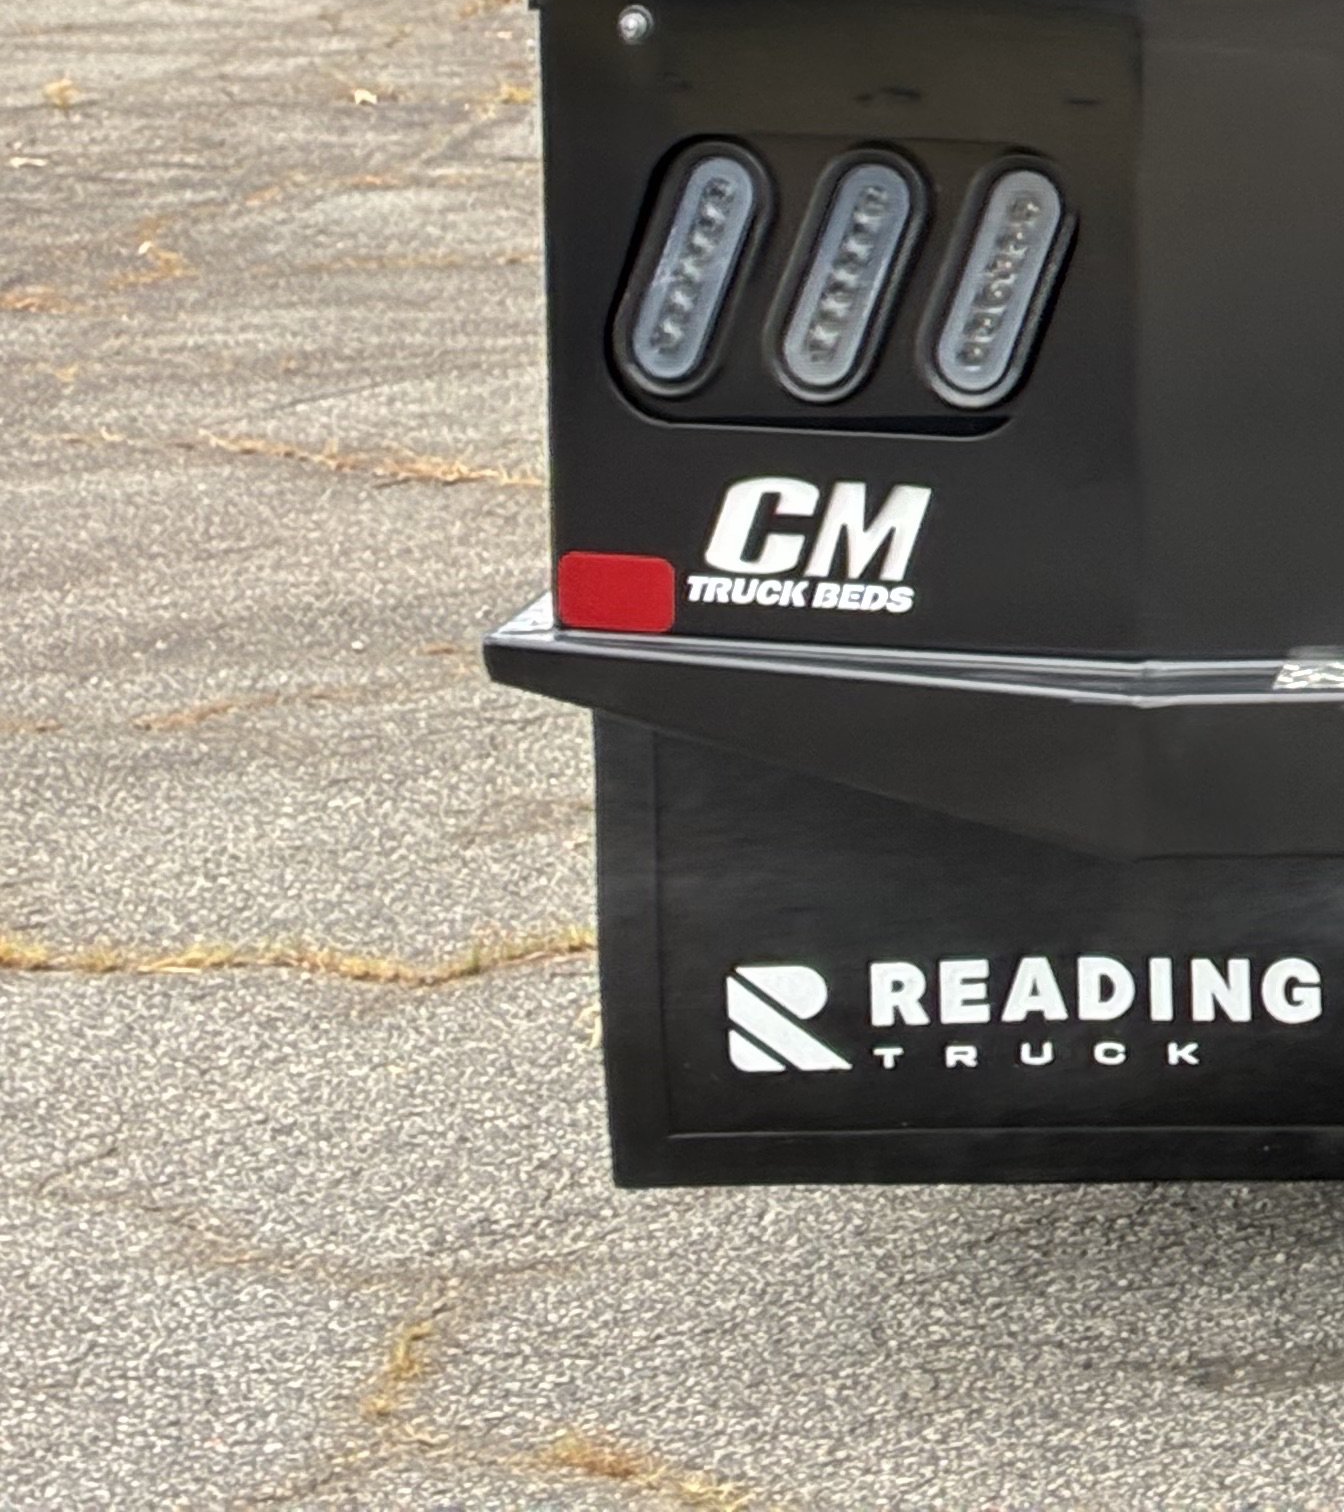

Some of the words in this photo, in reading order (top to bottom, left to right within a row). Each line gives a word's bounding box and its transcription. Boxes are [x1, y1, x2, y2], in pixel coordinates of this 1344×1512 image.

[704, 476, 932, 581] CM
[686, 575, 810, 607] TRUCK
[811, 582, 915, 613] BEDS
[869, 955, 1323, 1026] READING
[873, 1041, 1200, 1069] TRUCK
